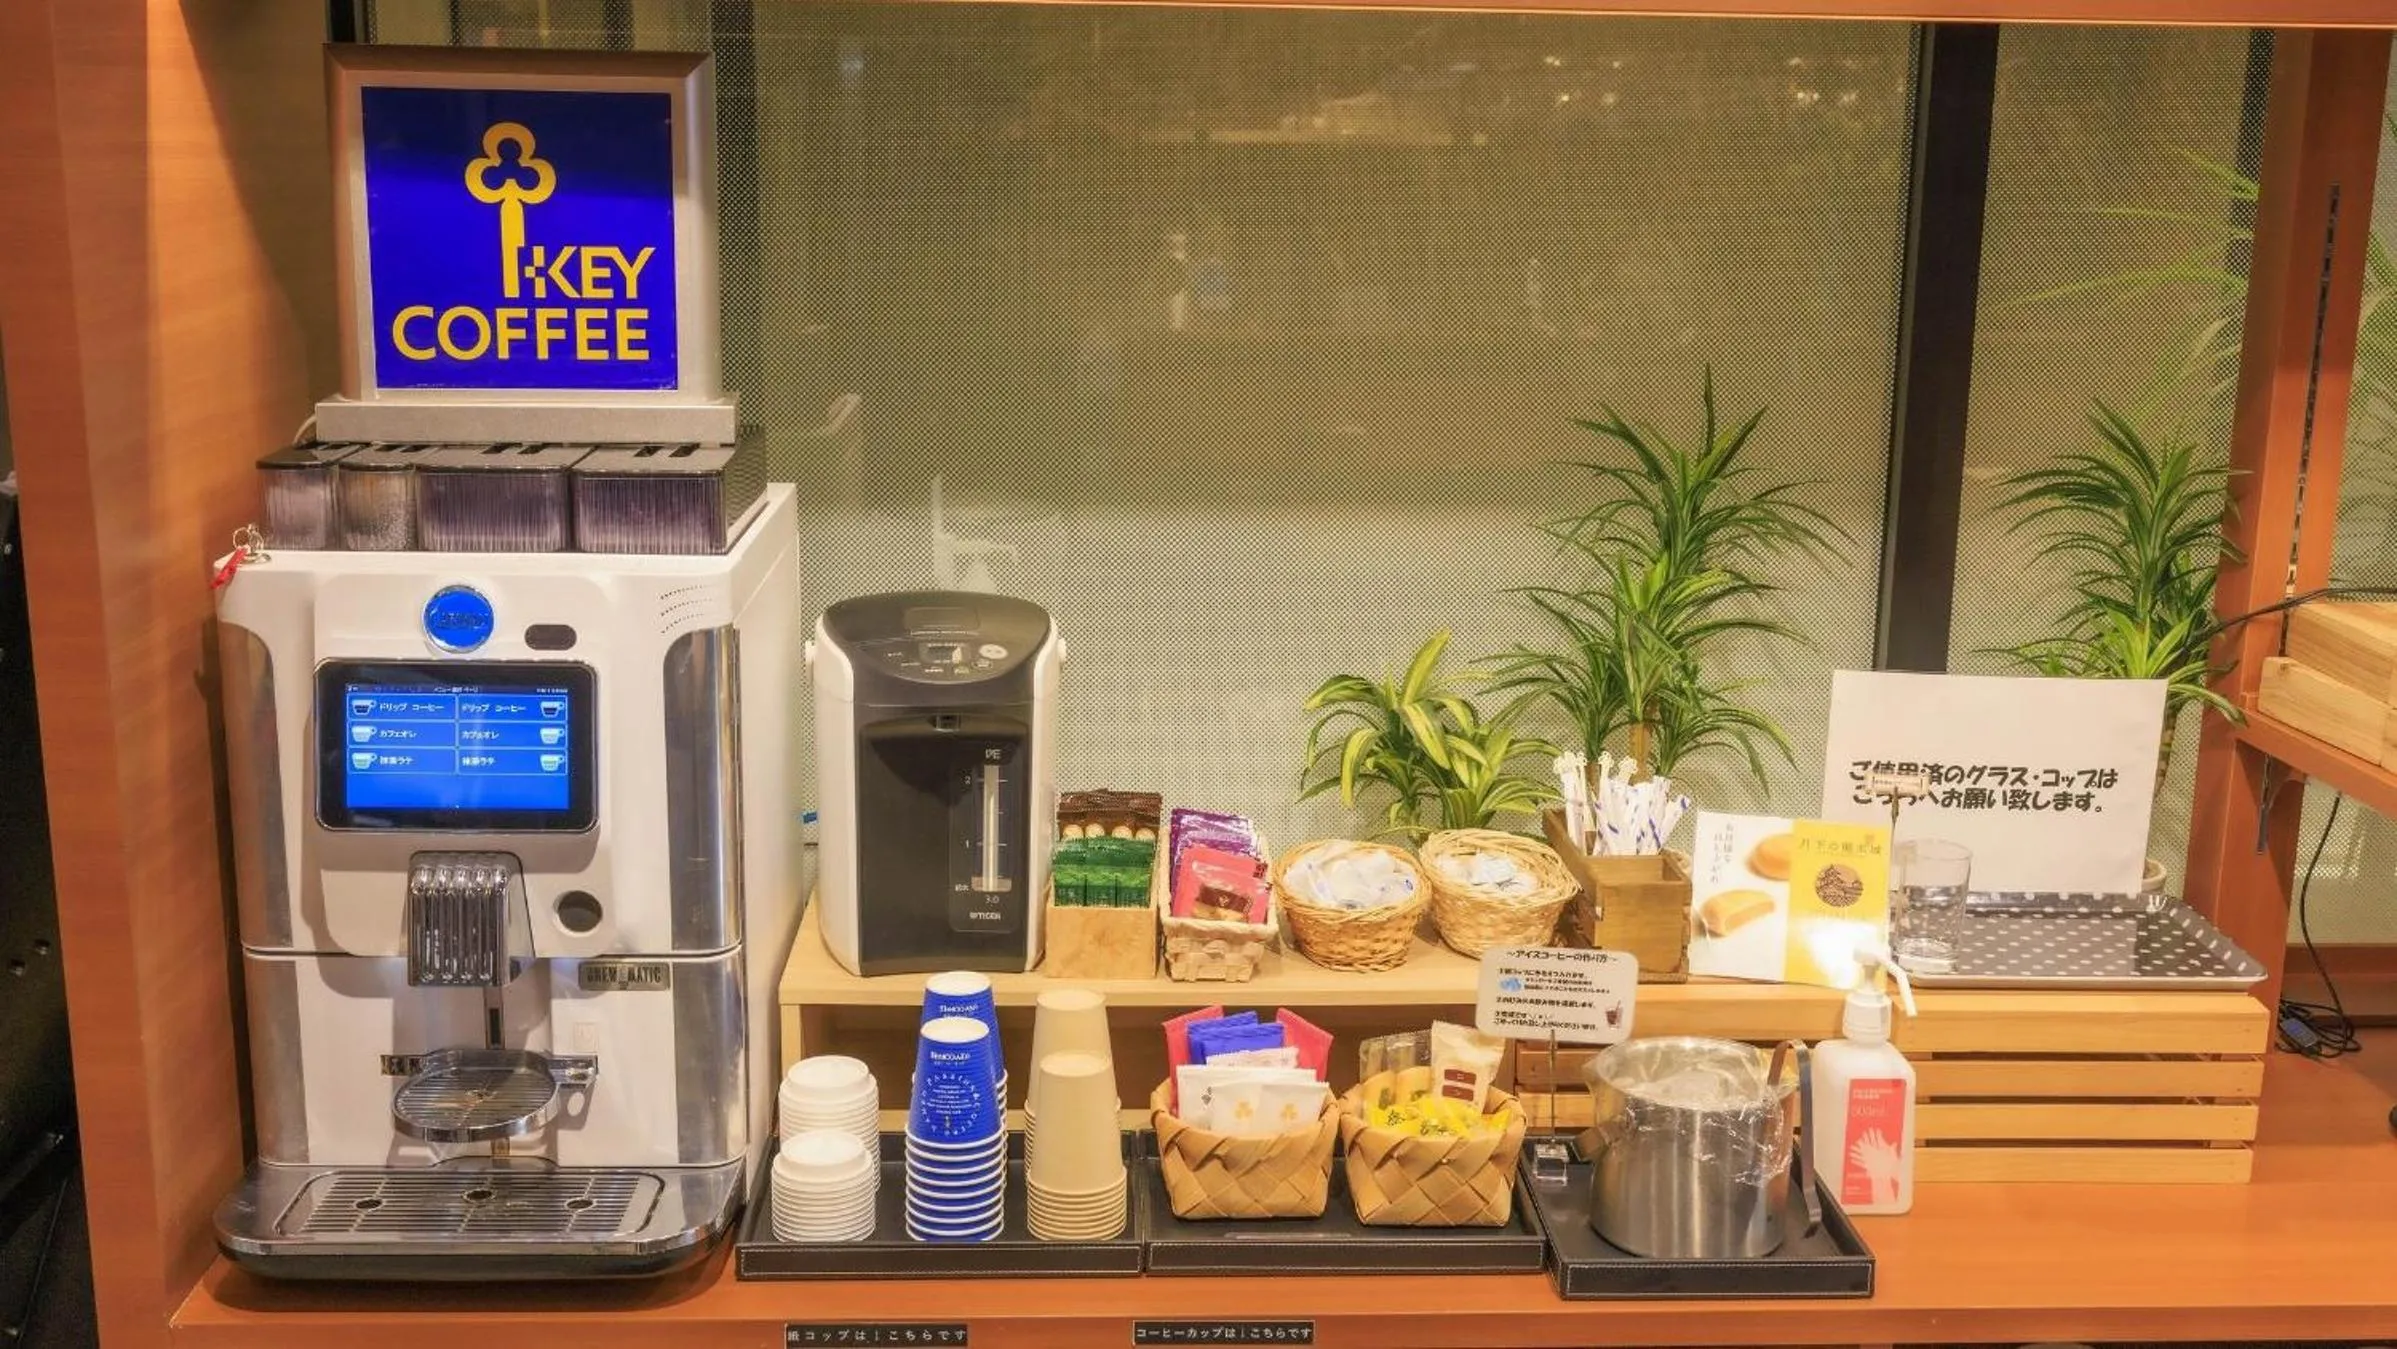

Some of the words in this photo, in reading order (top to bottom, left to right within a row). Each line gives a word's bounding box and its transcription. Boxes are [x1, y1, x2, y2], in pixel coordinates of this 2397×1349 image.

[524, 246, 655, 299] KEY
[392, 305, 650, 361] COFFEE
[412, 703, 445, 712] コーヒー
[495, 704, 527, 712] コーヒー
[888, 1330, 966, 1341] こちらです
[1250, 1327, 1312, 1339] こちらです
